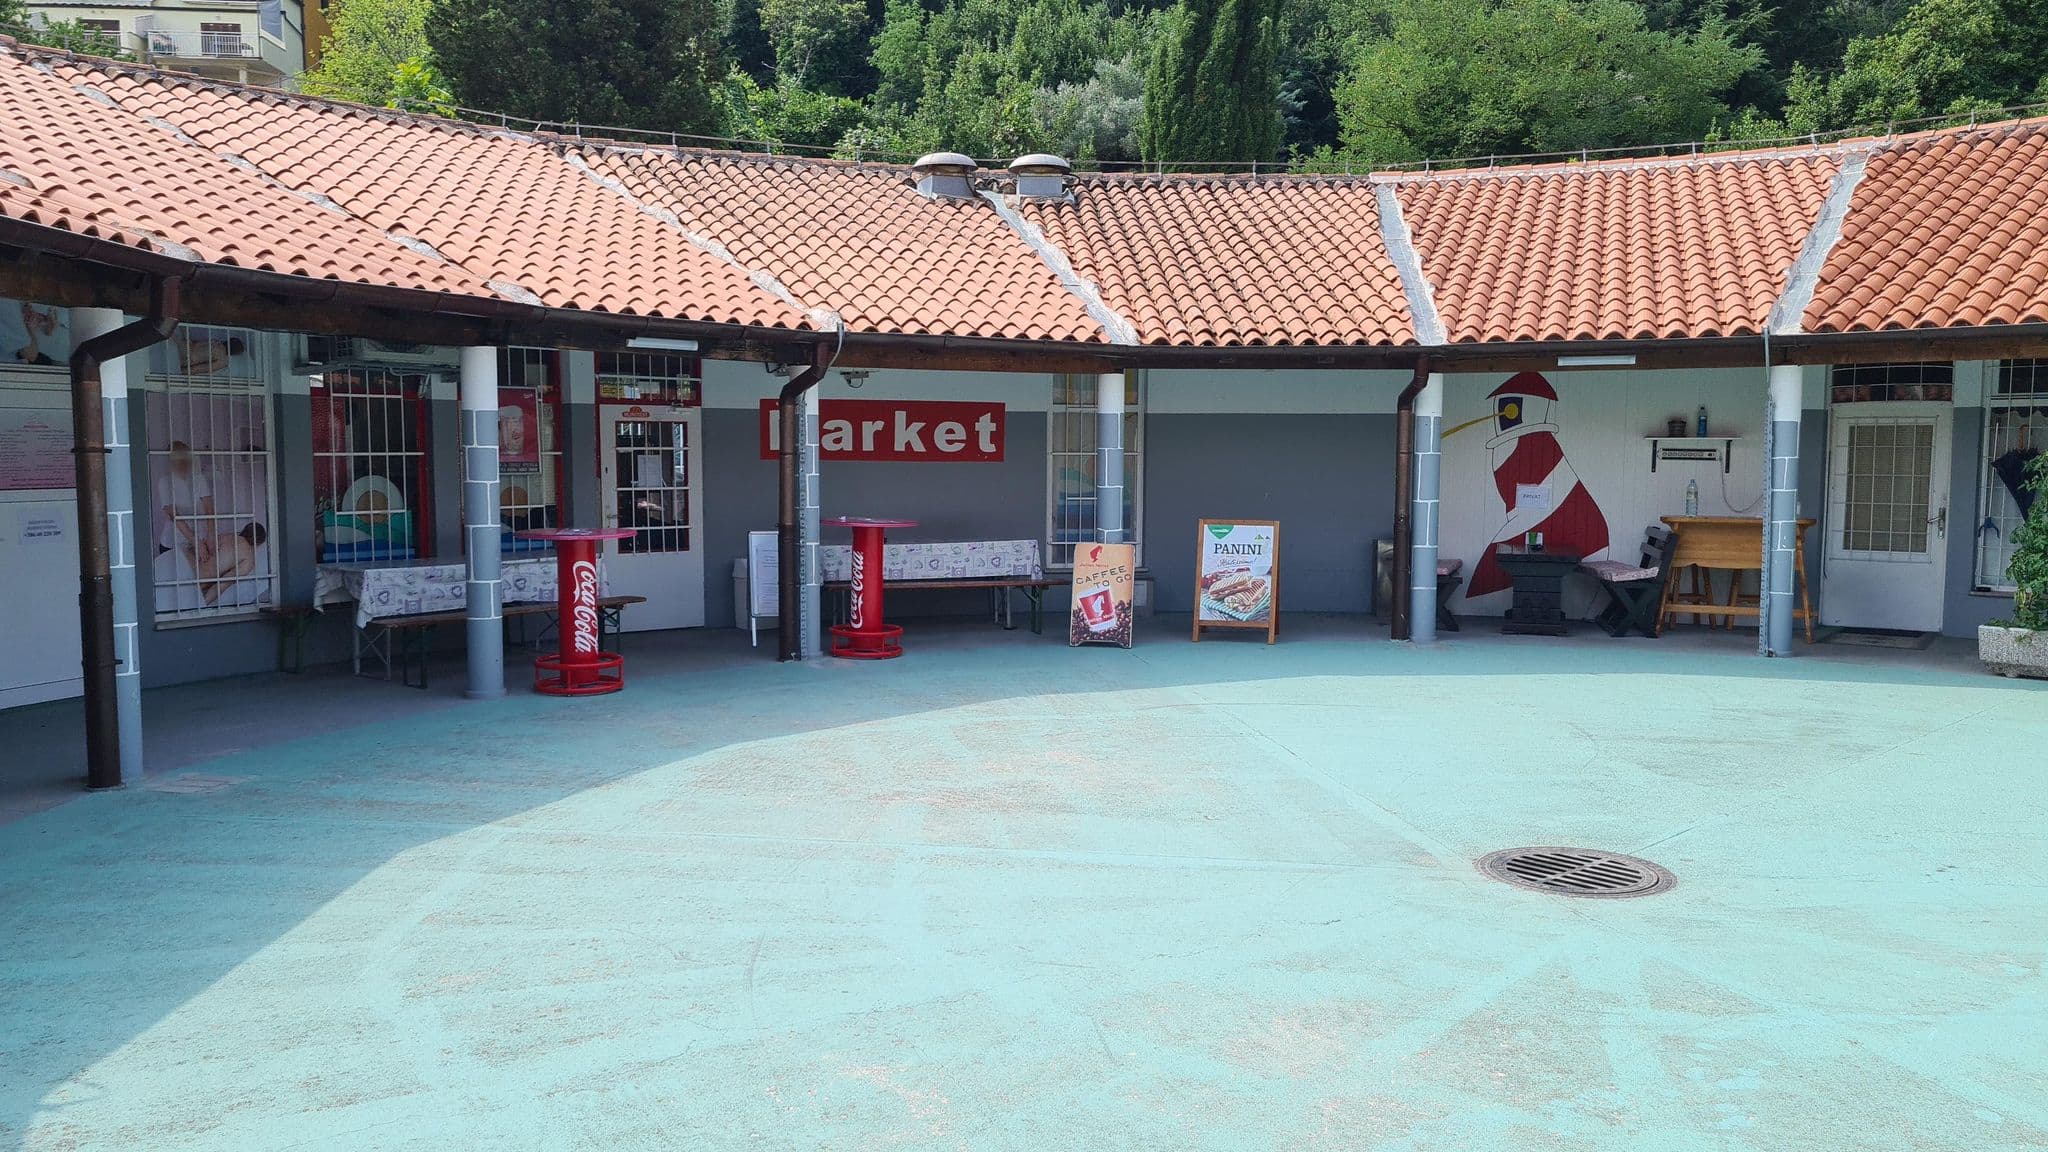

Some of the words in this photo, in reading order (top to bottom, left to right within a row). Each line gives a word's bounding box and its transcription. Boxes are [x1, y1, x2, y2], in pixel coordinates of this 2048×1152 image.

[1213, 543, 1262, 555] PANINI
[1075, 565, 1127, 585] CAFFEE
[1093, 580, 1110, 589] TO
[1115, 573, 1132, 583] GO
[573, 560, 599, 655] Coca-Cola
